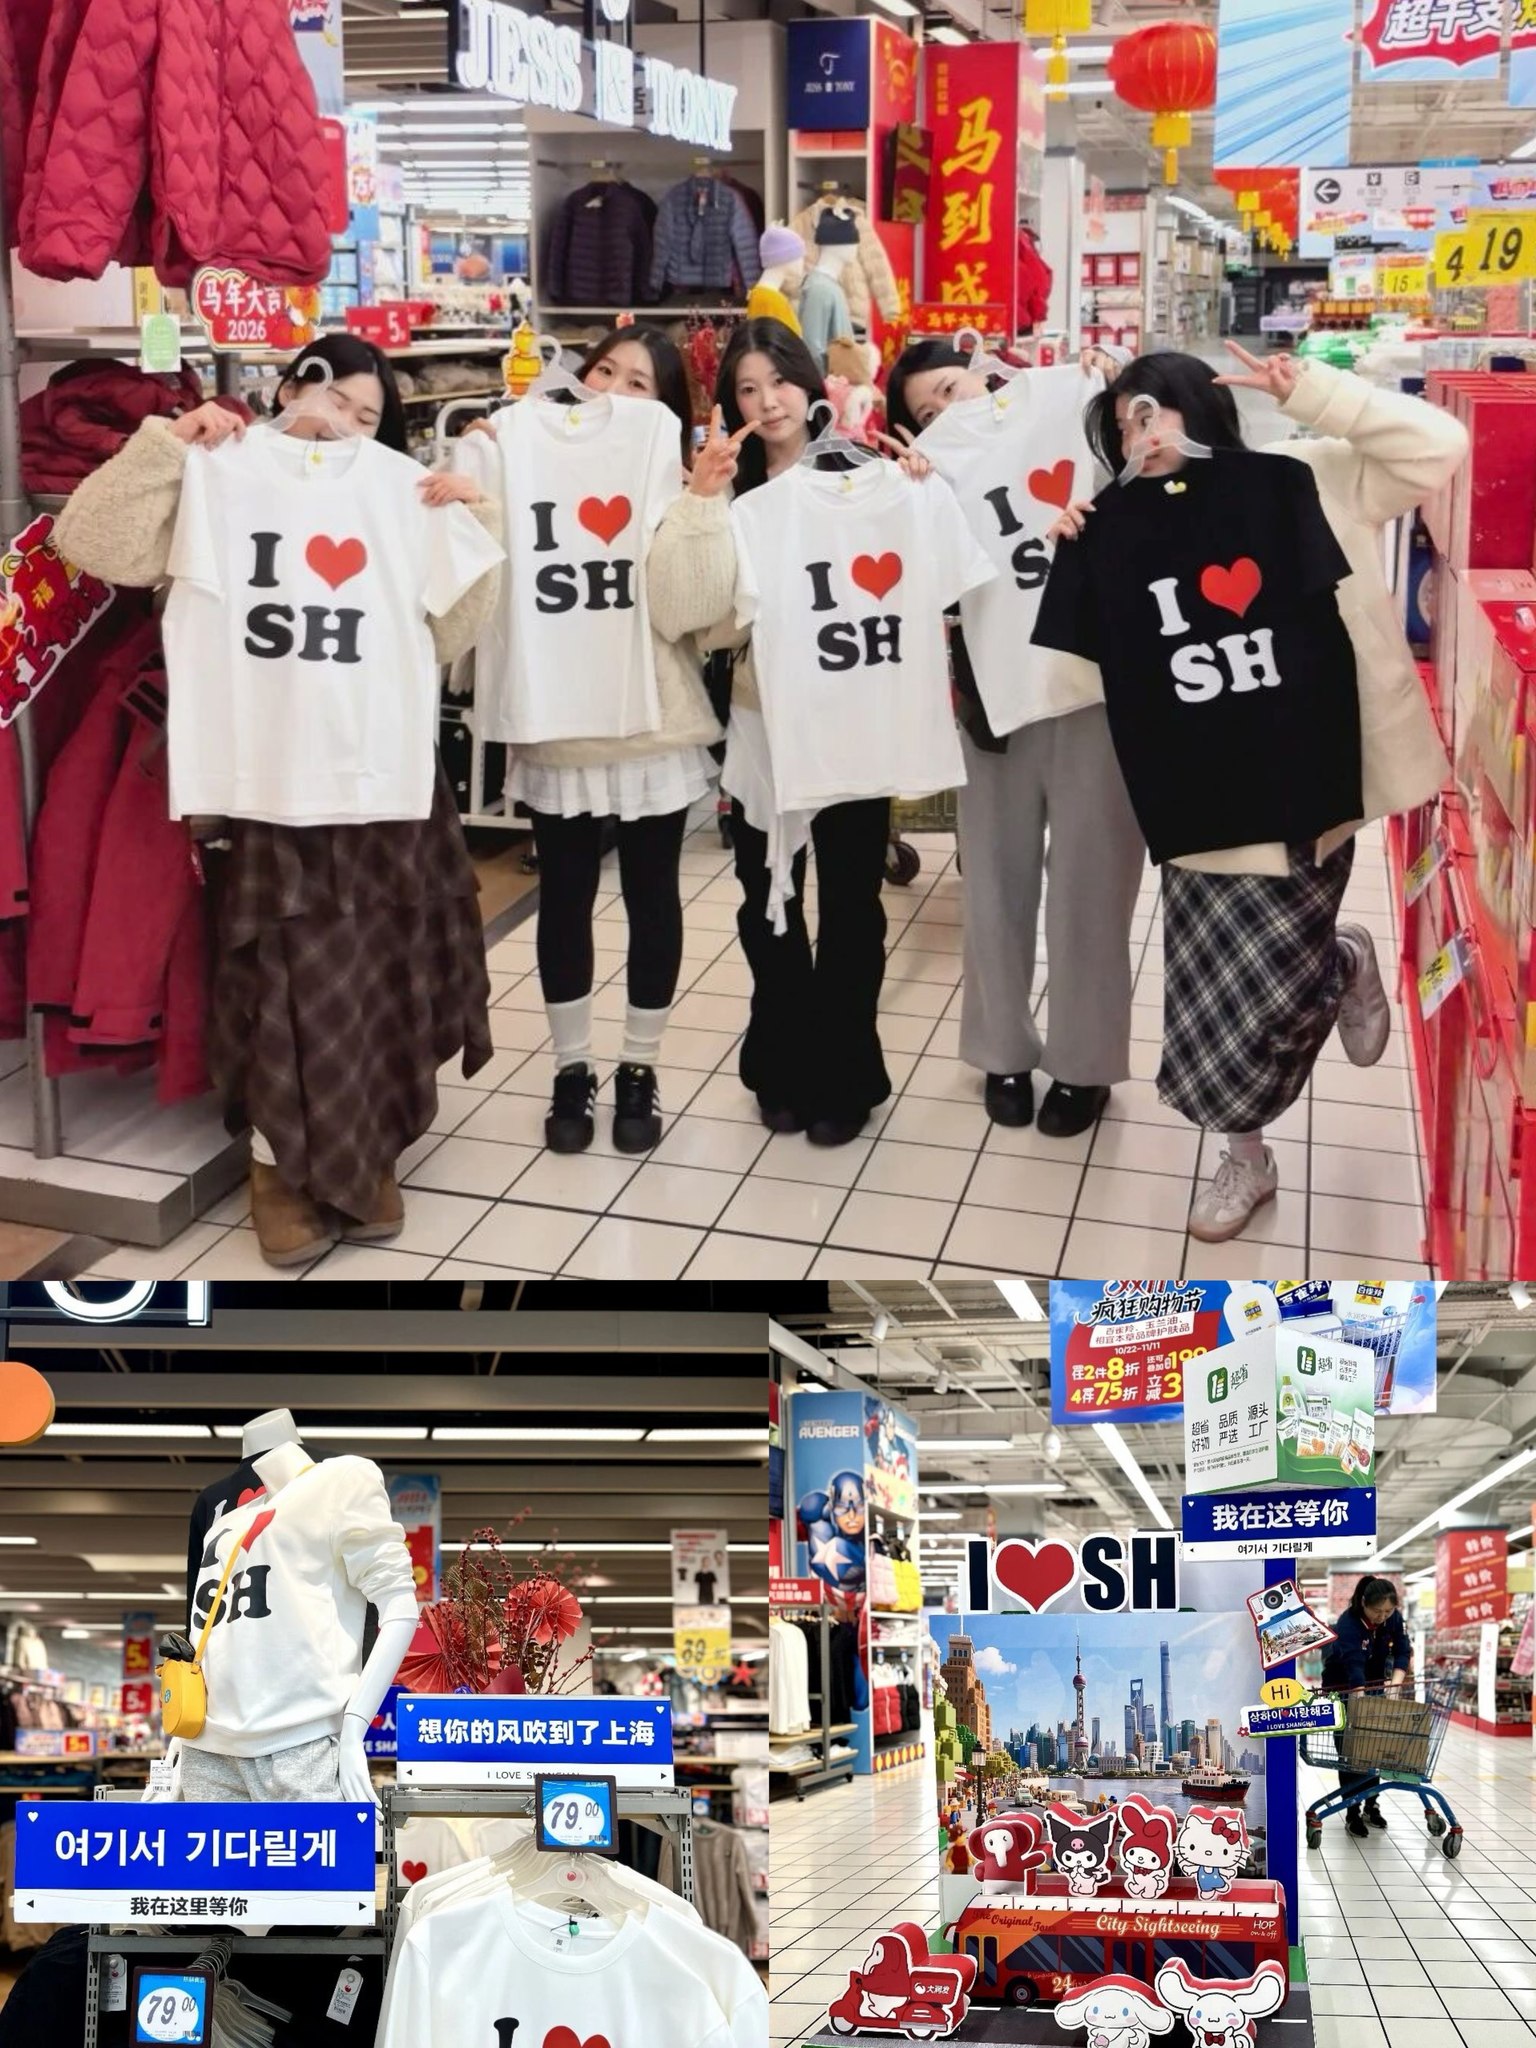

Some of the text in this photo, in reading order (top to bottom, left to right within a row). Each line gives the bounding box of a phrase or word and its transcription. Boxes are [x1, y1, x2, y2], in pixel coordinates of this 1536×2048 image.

[644, 57, 738, 151] TONY
[1447, 246, 1464, 281] 4
[1479, 227, 1523, 271] 19
[202, 279, 282, 317] 马年大吉
[228, 319, 266, 341] 2026
[530, 501, 560, 552] I
[983, 485, 1024, 537] I
[249, 532, 280, 588] I
[535, 559, 635, 614] SH
[806, 561, 838, 612] I
[1148, 576, 1191, 637] I
[244, 603, 366, 664] SH
[817, 614, 903, 672] SH
[1169, 628, 1282, 703] SH
[1091, 1290, 1202, 1321] 疯狂购物节
[799, 1424, 860, 1439] AVENGER
[1219, 1410, 1238, 1429] 品质
[1248, 1402, 1269, 1421] 源头
[1191, 1420, 1269, 1453] 好物 严选 工厂
[1212, 1499, 1350, 1532] 我在这等你
[200, 1527, 232, 1568] I
[1238, 1542, 1313, 1555] 여기서 기다릴게
[969, 1536, 1176, 1611] I SH
[193, 1564, 272, 1630] SH
[1271, 1684, 1290, 1700] Hi
[1250, 1706, 1332, 1722] 상하이 사랑해요
[418, 1718, 655, 1746] 想你的风吹到了上海
[496, 1771, 521, 1779] LOVE
[55, 1829, 336, 1867] 여기서 기다릴게
[131, 1896, 248, 1916] 我在这里等你
[991, 1914, 1033, 1927] Original
[1096, 1915, 1221, 1938] City Sightseeing
[1253, 1920, 1276, 1929] HOP
[1052, 1974, 1072, 1993] 24
